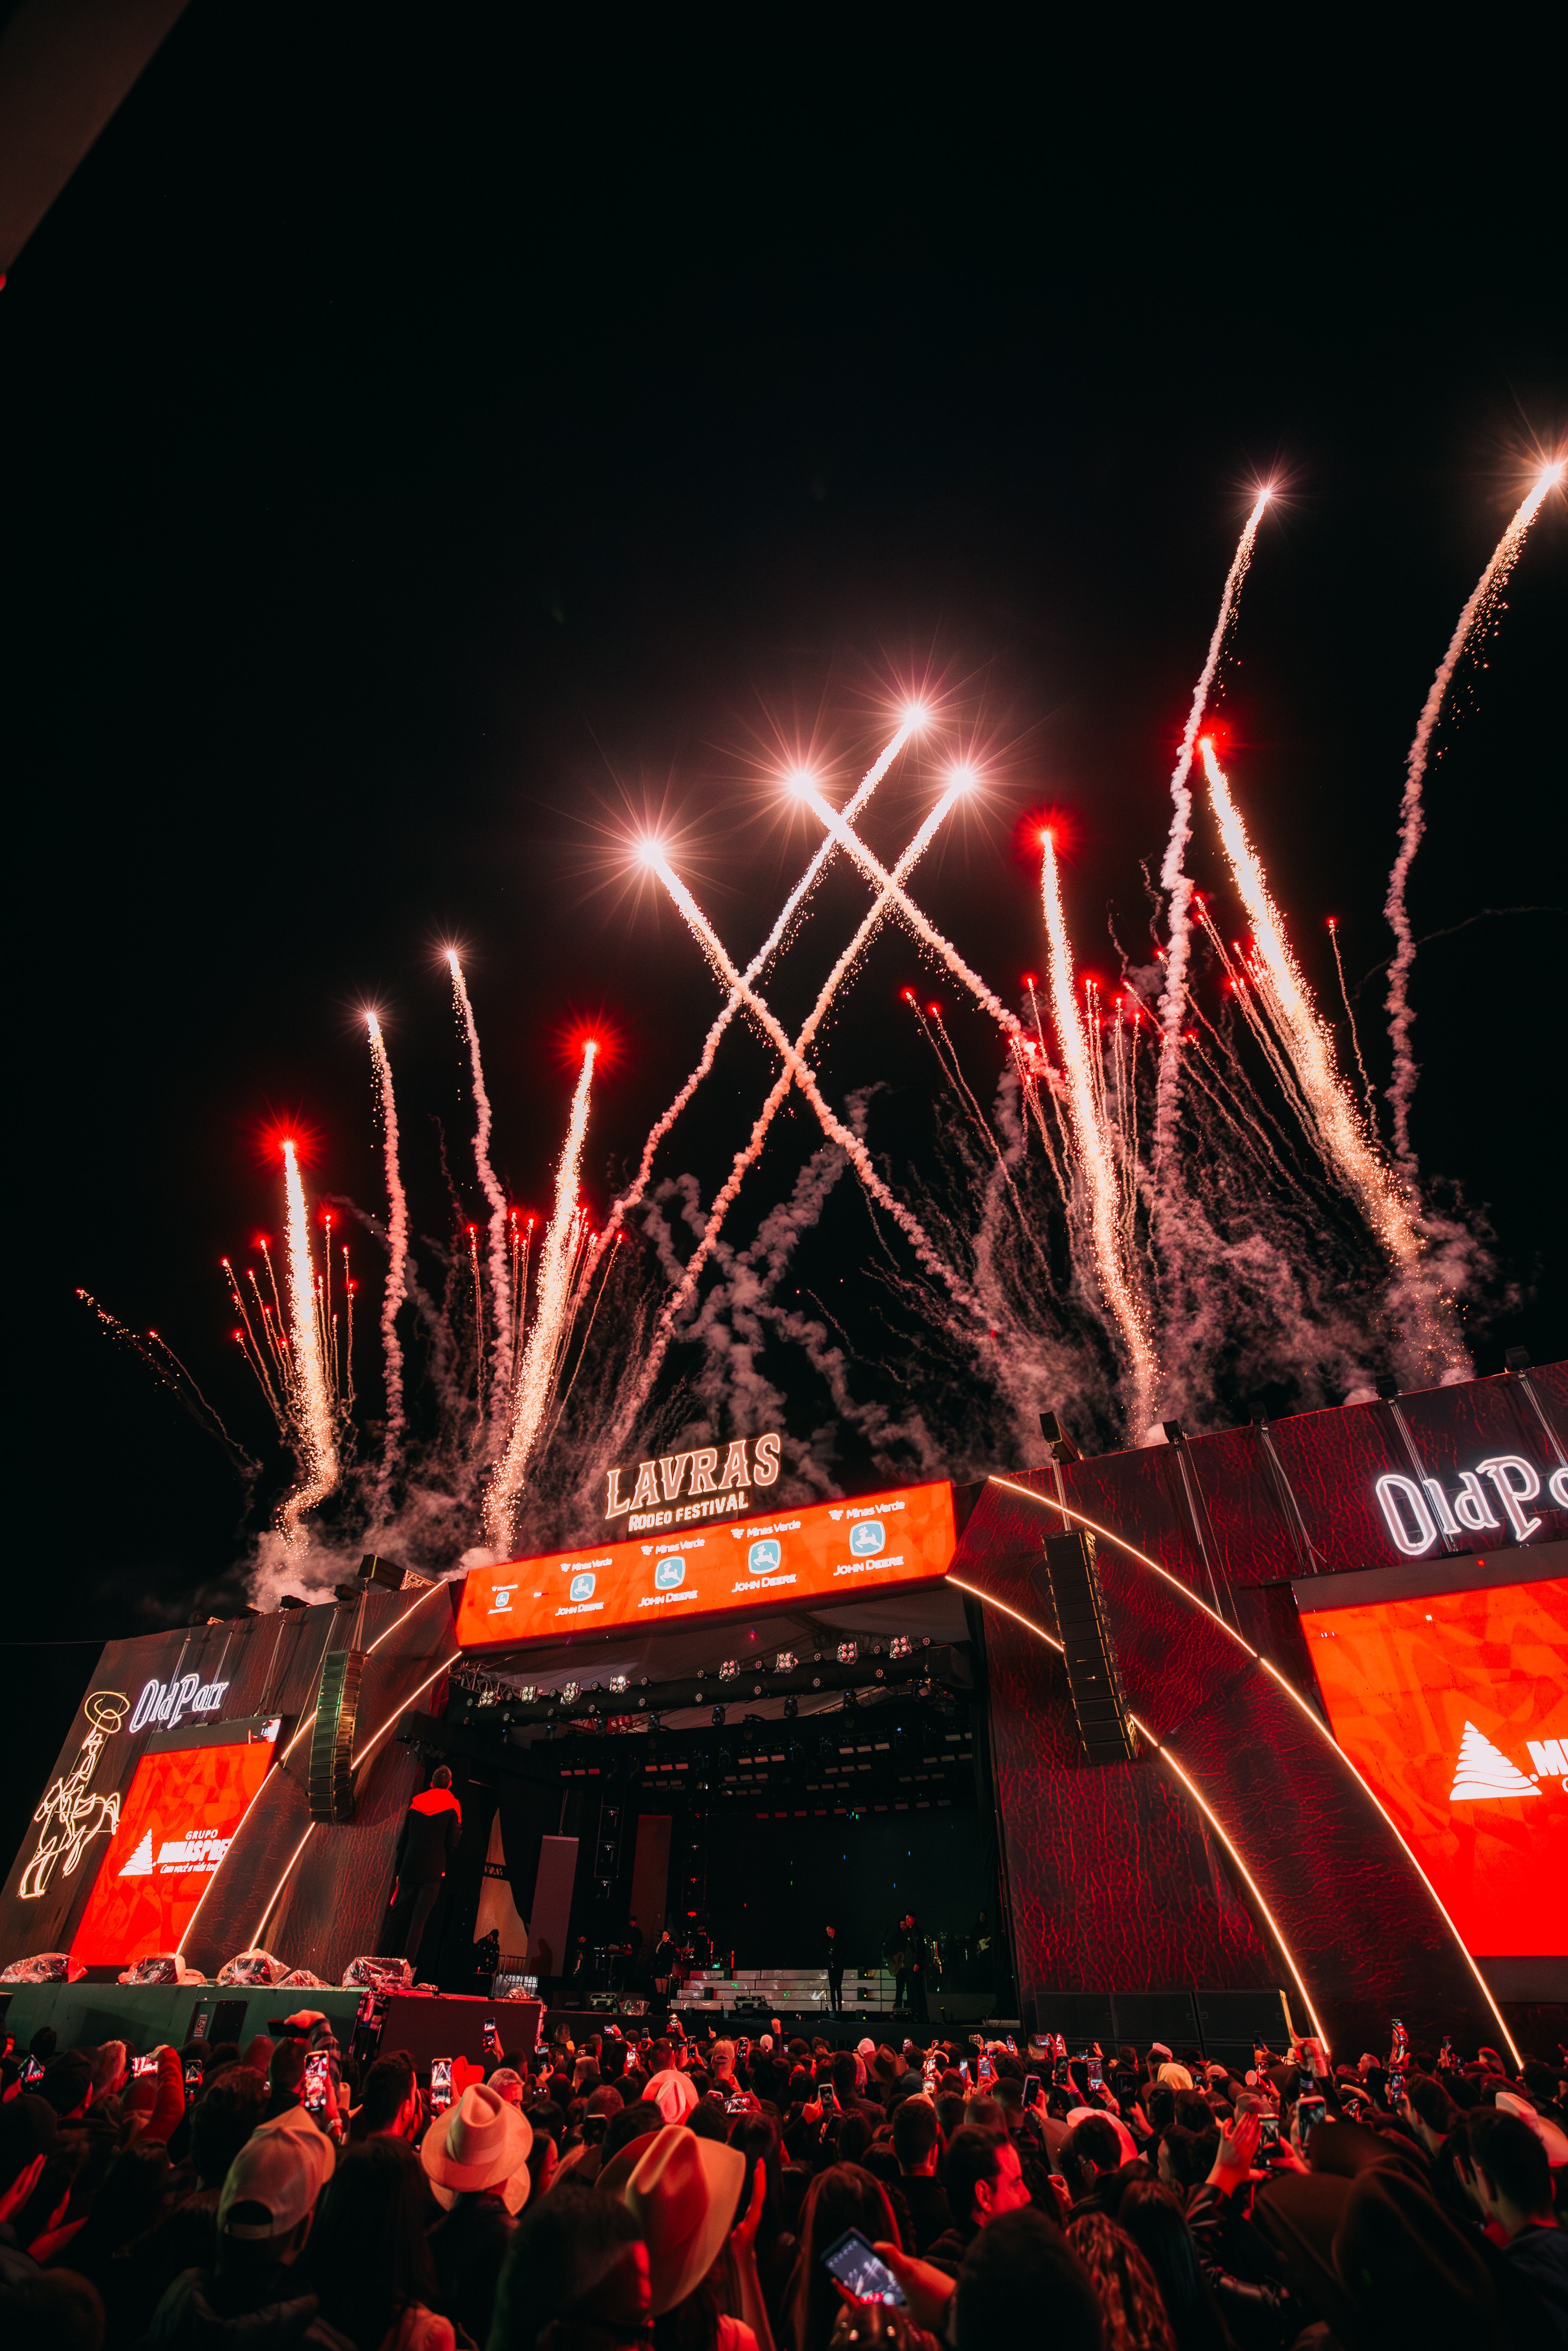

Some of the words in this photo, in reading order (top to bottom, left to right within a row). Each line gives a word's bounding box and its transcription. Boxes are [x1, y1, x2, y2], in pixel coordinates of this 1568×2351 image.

[605, 1433, 781, 1520] LAVRAS
[628, 1511, 672, 1532] RODEO
[675, 1491, 749, 1522] FESTIVAL
[846, 1507, 875, 1519] Minas
[875, 1501, 906, 1514] Verde
[746, 1527, 773, 1538] Minas
[773, 1520, 802, 1533] Verde
[655, 1544, 680, 1555] Minas
[679, 1538, 705, 1549] Verde
[833, 1562, 865, 1576] JOHN
[866, 1556, 904, 1571] DEERE
[731, 1580, 760, 1593] JOHN
[761, 1573, 797, 1588] DEERE
[637, 1596, 665, 1607] JOHN
[185, 1829, 218, 1840] GRUPO
[156, 1838, 233, 1864] MINASPRE
